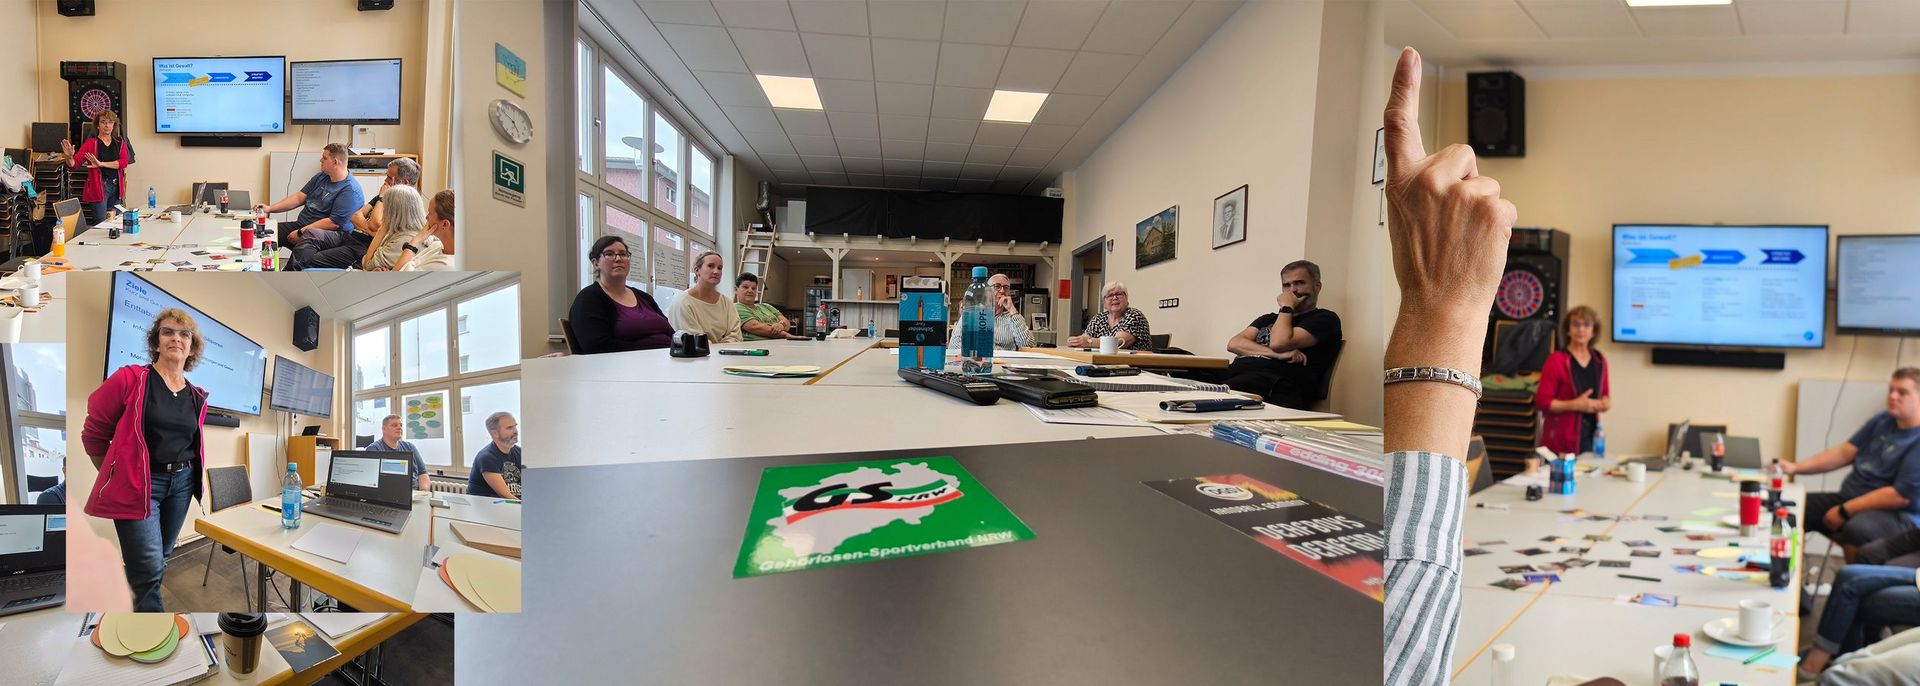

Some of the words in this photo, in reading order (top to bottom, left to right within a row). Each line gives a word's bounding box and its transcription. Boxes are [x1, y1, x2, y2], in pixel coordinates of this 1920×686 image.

[125, 280, 147, 295] Ziele
[124, 299, 156, 319] Enttabu
[1288, 447, 1349, 472] edding
[792, 480, 894, 512] GS
[896, 486, 948, 503] NRW
[759, 535, 973, 572] Gehörlosen-Sportverband
[976, 530, 1014, 544] NRW
